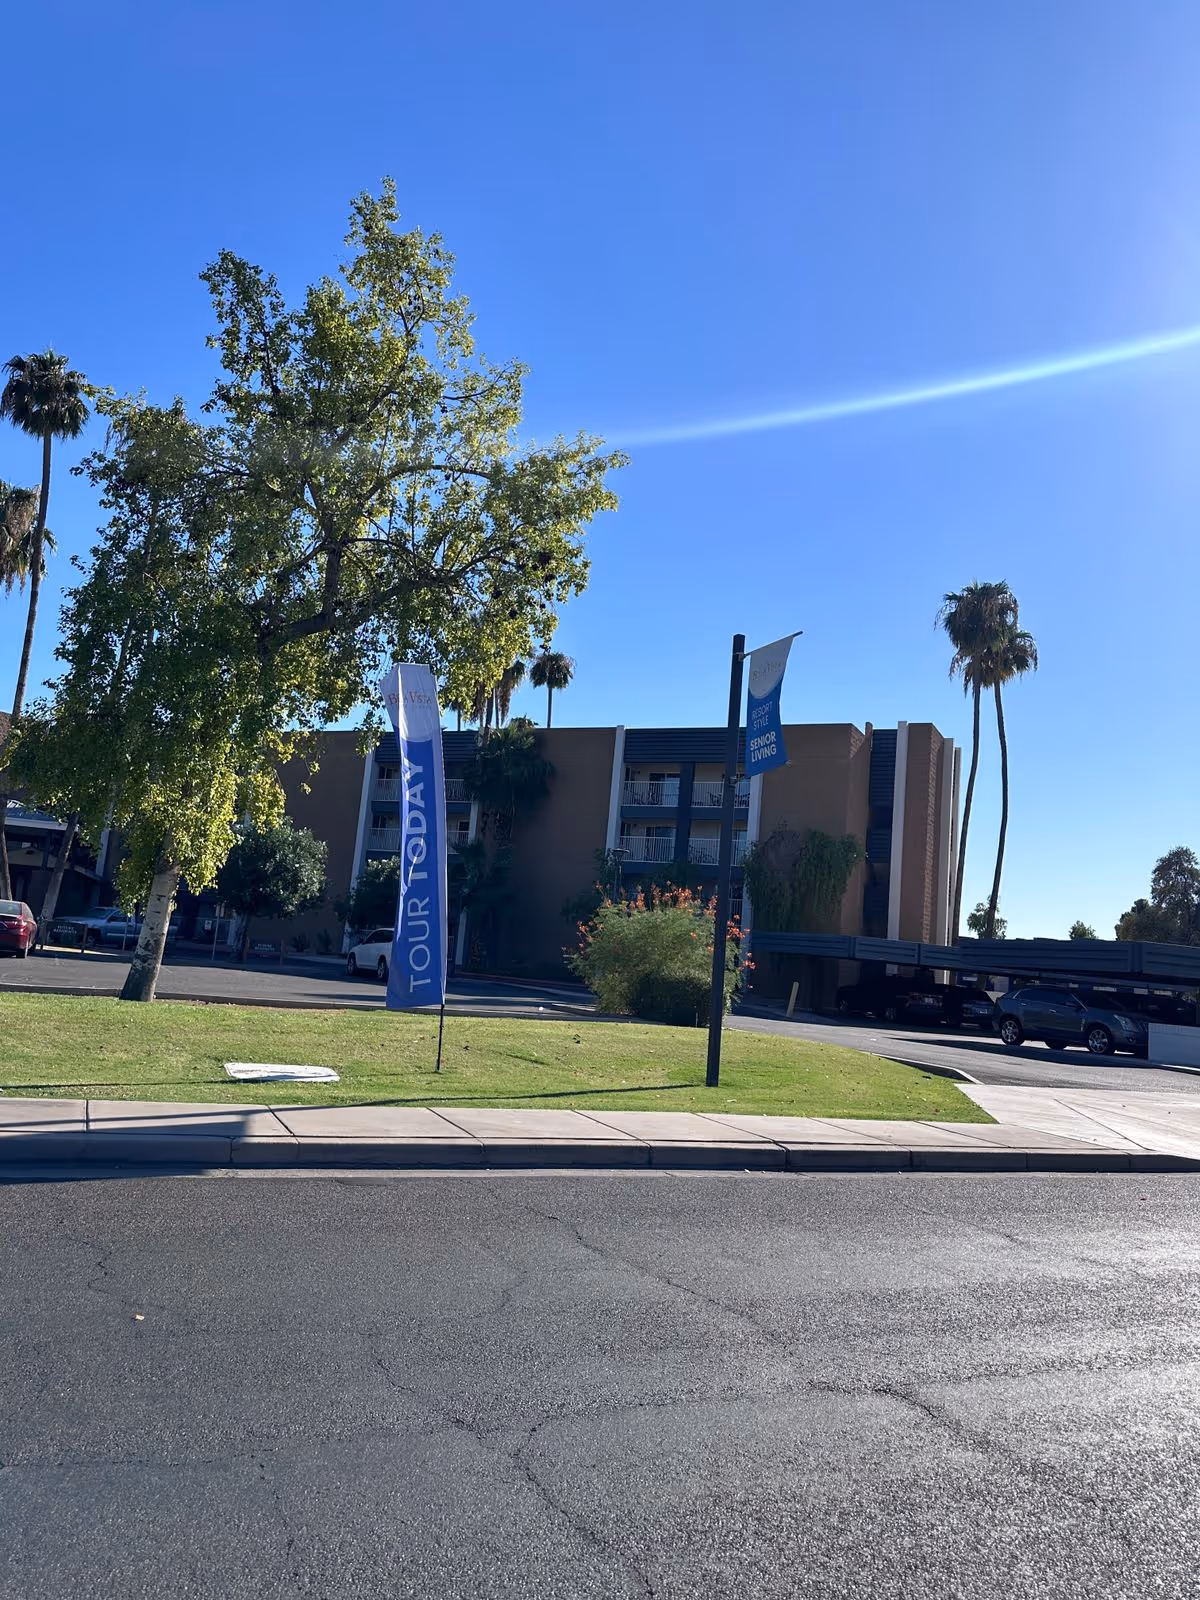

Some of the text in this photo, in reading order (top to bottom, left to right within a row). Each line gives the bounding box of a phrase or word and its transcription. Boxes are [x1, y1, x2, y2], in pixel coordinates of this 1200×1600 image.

[752, 701, 773, 720] RESORT
[753, 715, 769, 731] STYLE
[750, 731, 777, 751] SENIOR
[751, 744, 777, 763] LIVING
[404, 756, 431, 993] TOUR TODAY
